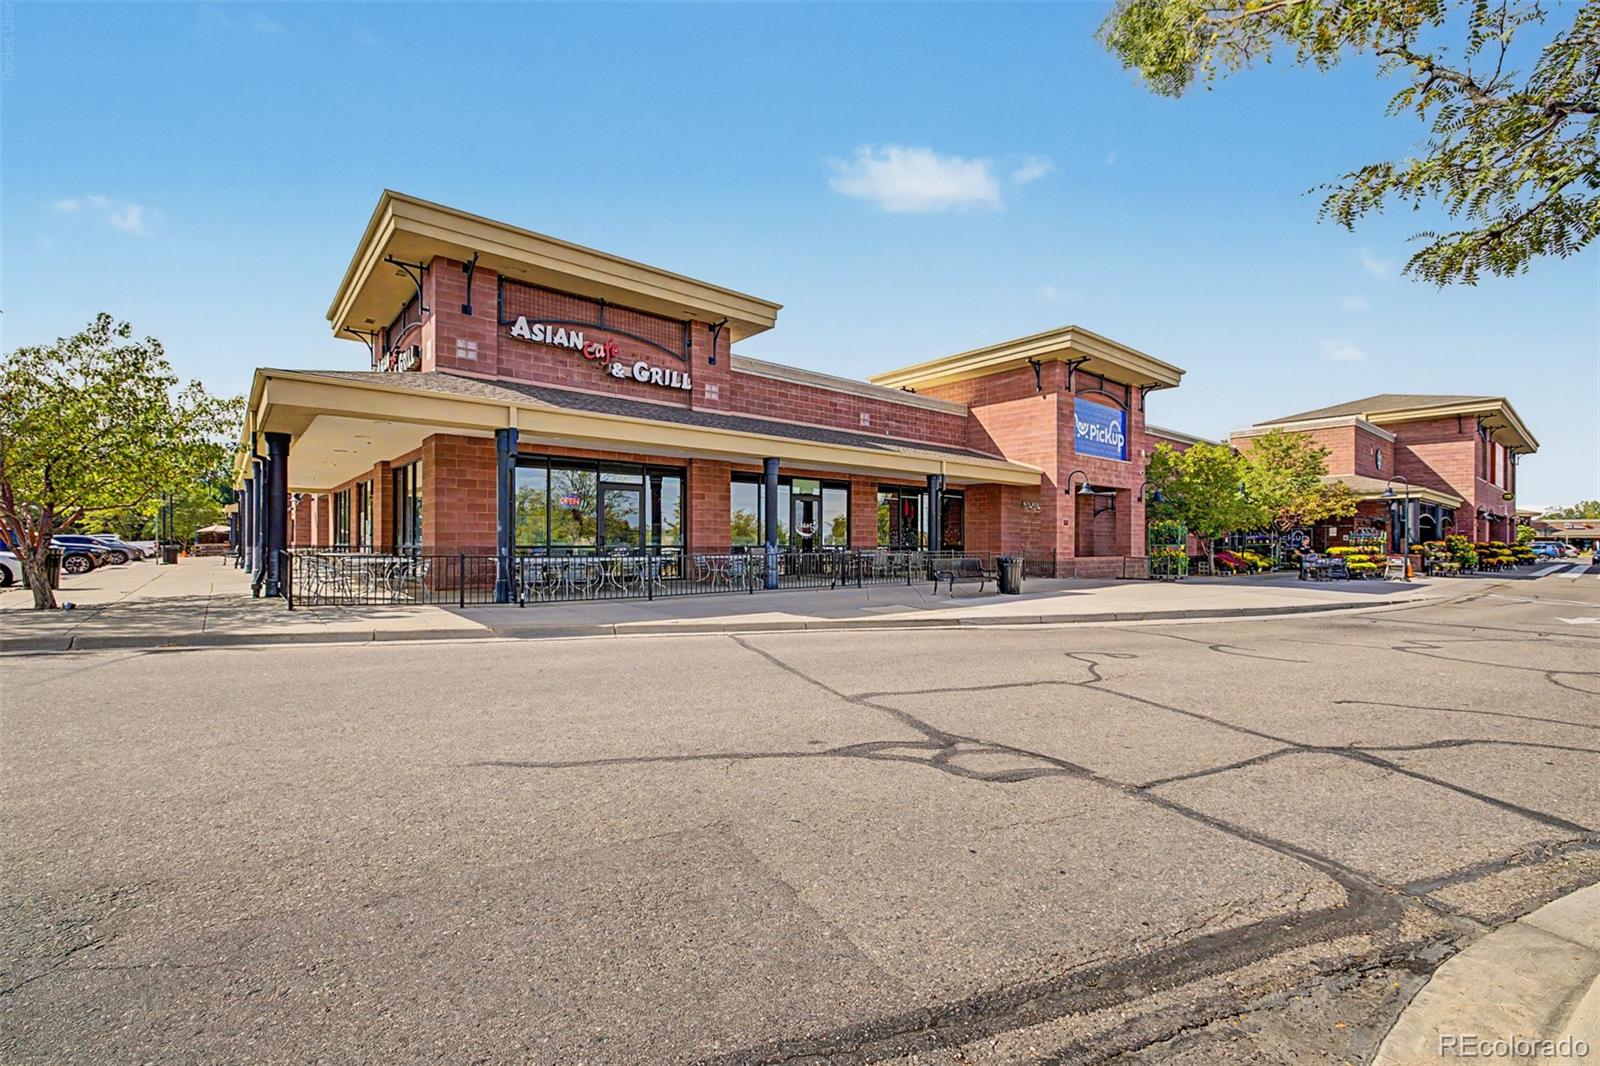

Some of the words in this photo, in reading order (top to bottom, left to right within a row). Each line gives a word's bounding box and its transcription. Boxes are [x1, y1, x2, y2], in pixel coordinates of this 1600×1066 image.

[510, 315, 584, 351] ASIAN
[609, 362, 625, 379] &
[632, 361, 692, 390] GRILL
